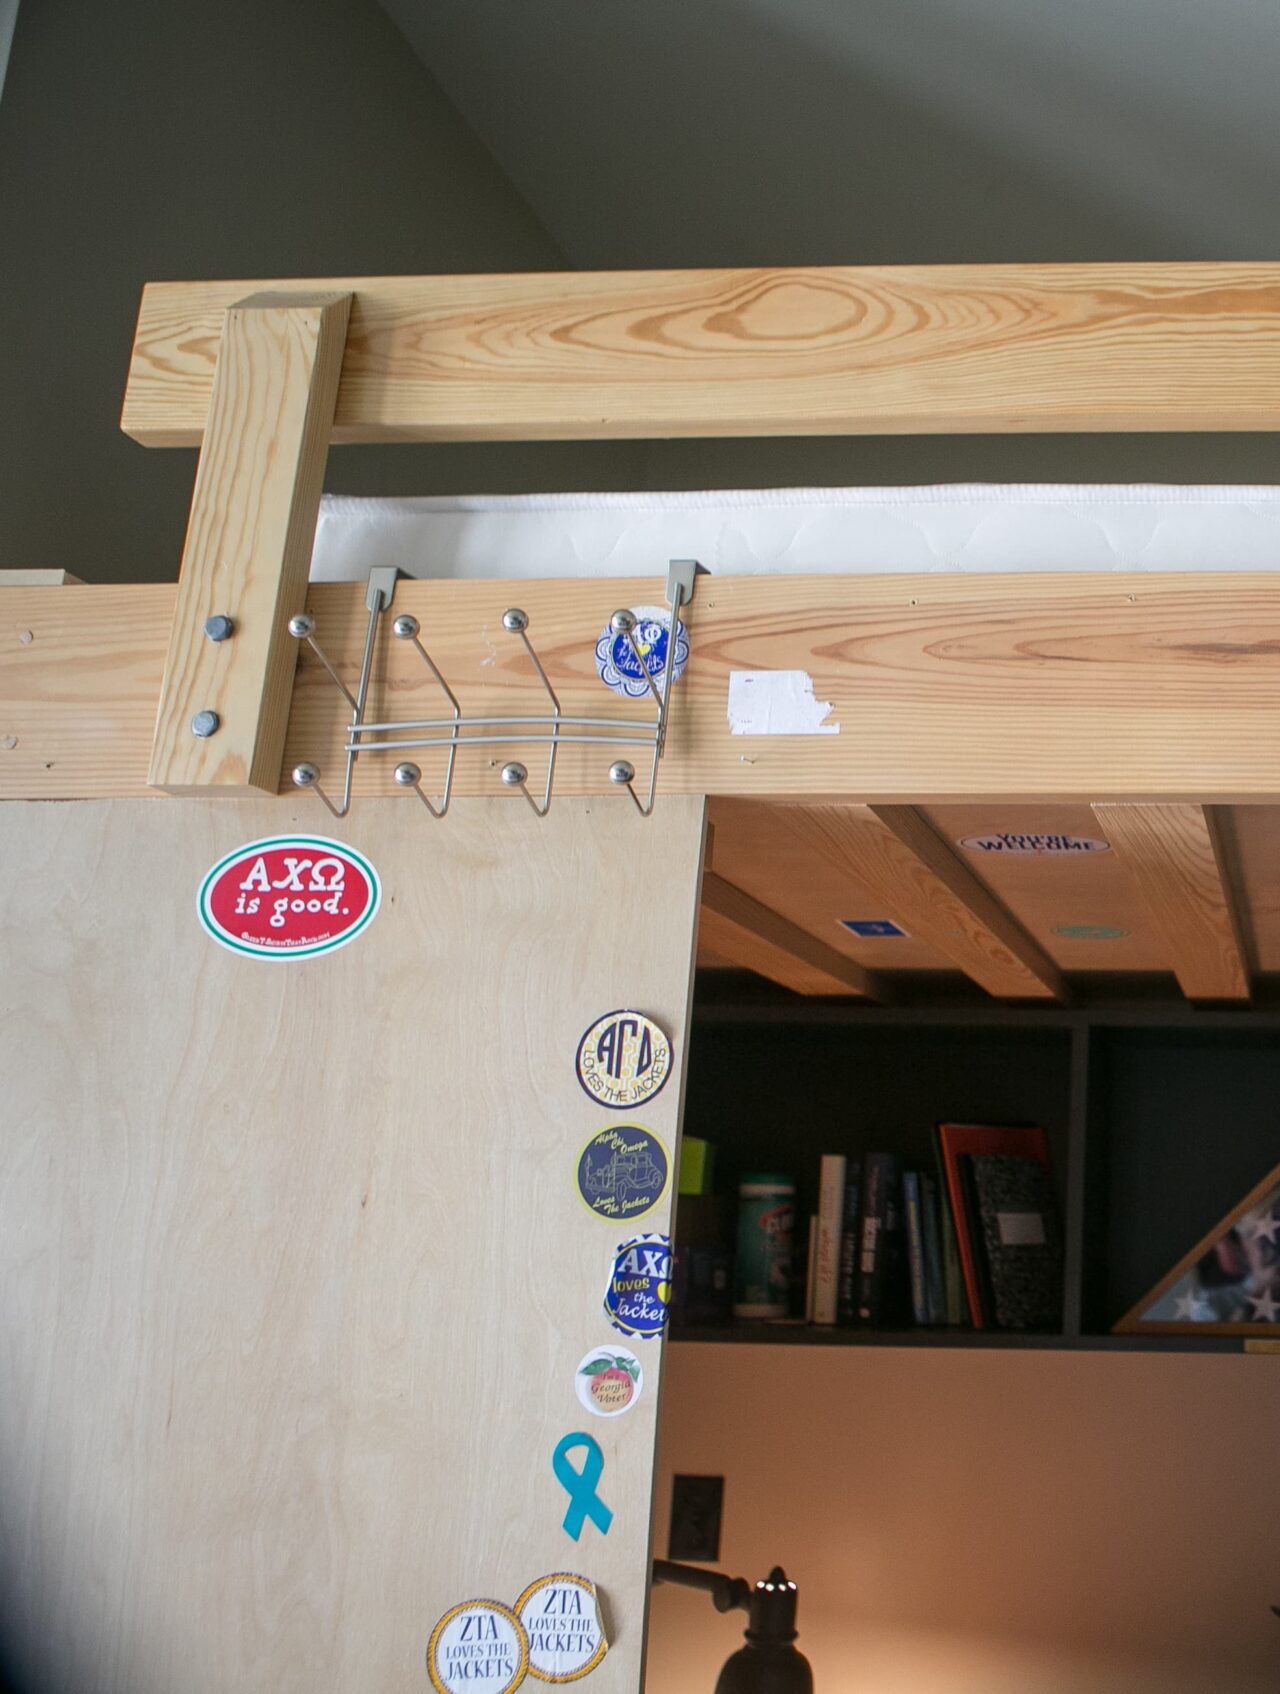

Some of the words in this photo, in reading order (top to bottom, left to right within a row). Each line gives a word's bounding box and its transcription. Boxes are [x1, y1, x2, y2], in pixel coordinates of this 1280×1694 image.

[615, 653, 664, 676] Jacets
[977, 841, 1097, 851] WELCOME
[234, 893, 261, 915] is
[269, 891, 350, 928] good.
[583, 1049, 604, 1092] LOVES
[604, 1086, 628, 1102] THE
[631, 1047, 666, 1100] JACKETS
[612, 1277, 651, 1294] loves
[633, 1292, 656, 1305] the
[591, 1380, 632, 1394] Georgia
[543, 1588, 582, 1616] ZTA
[460, 1614, 499, 1642] ZTA
[528, 1617, 566, 1631] LOVES
[567, 1617, 594, 1633] THE
[446, 1645, 486, 1660] LOVES
[486, 1642, 511, 1657] THE
[528, 1633, 595, 1653] JACKETS
[445, 1657, 514, 1681] JACKETS
